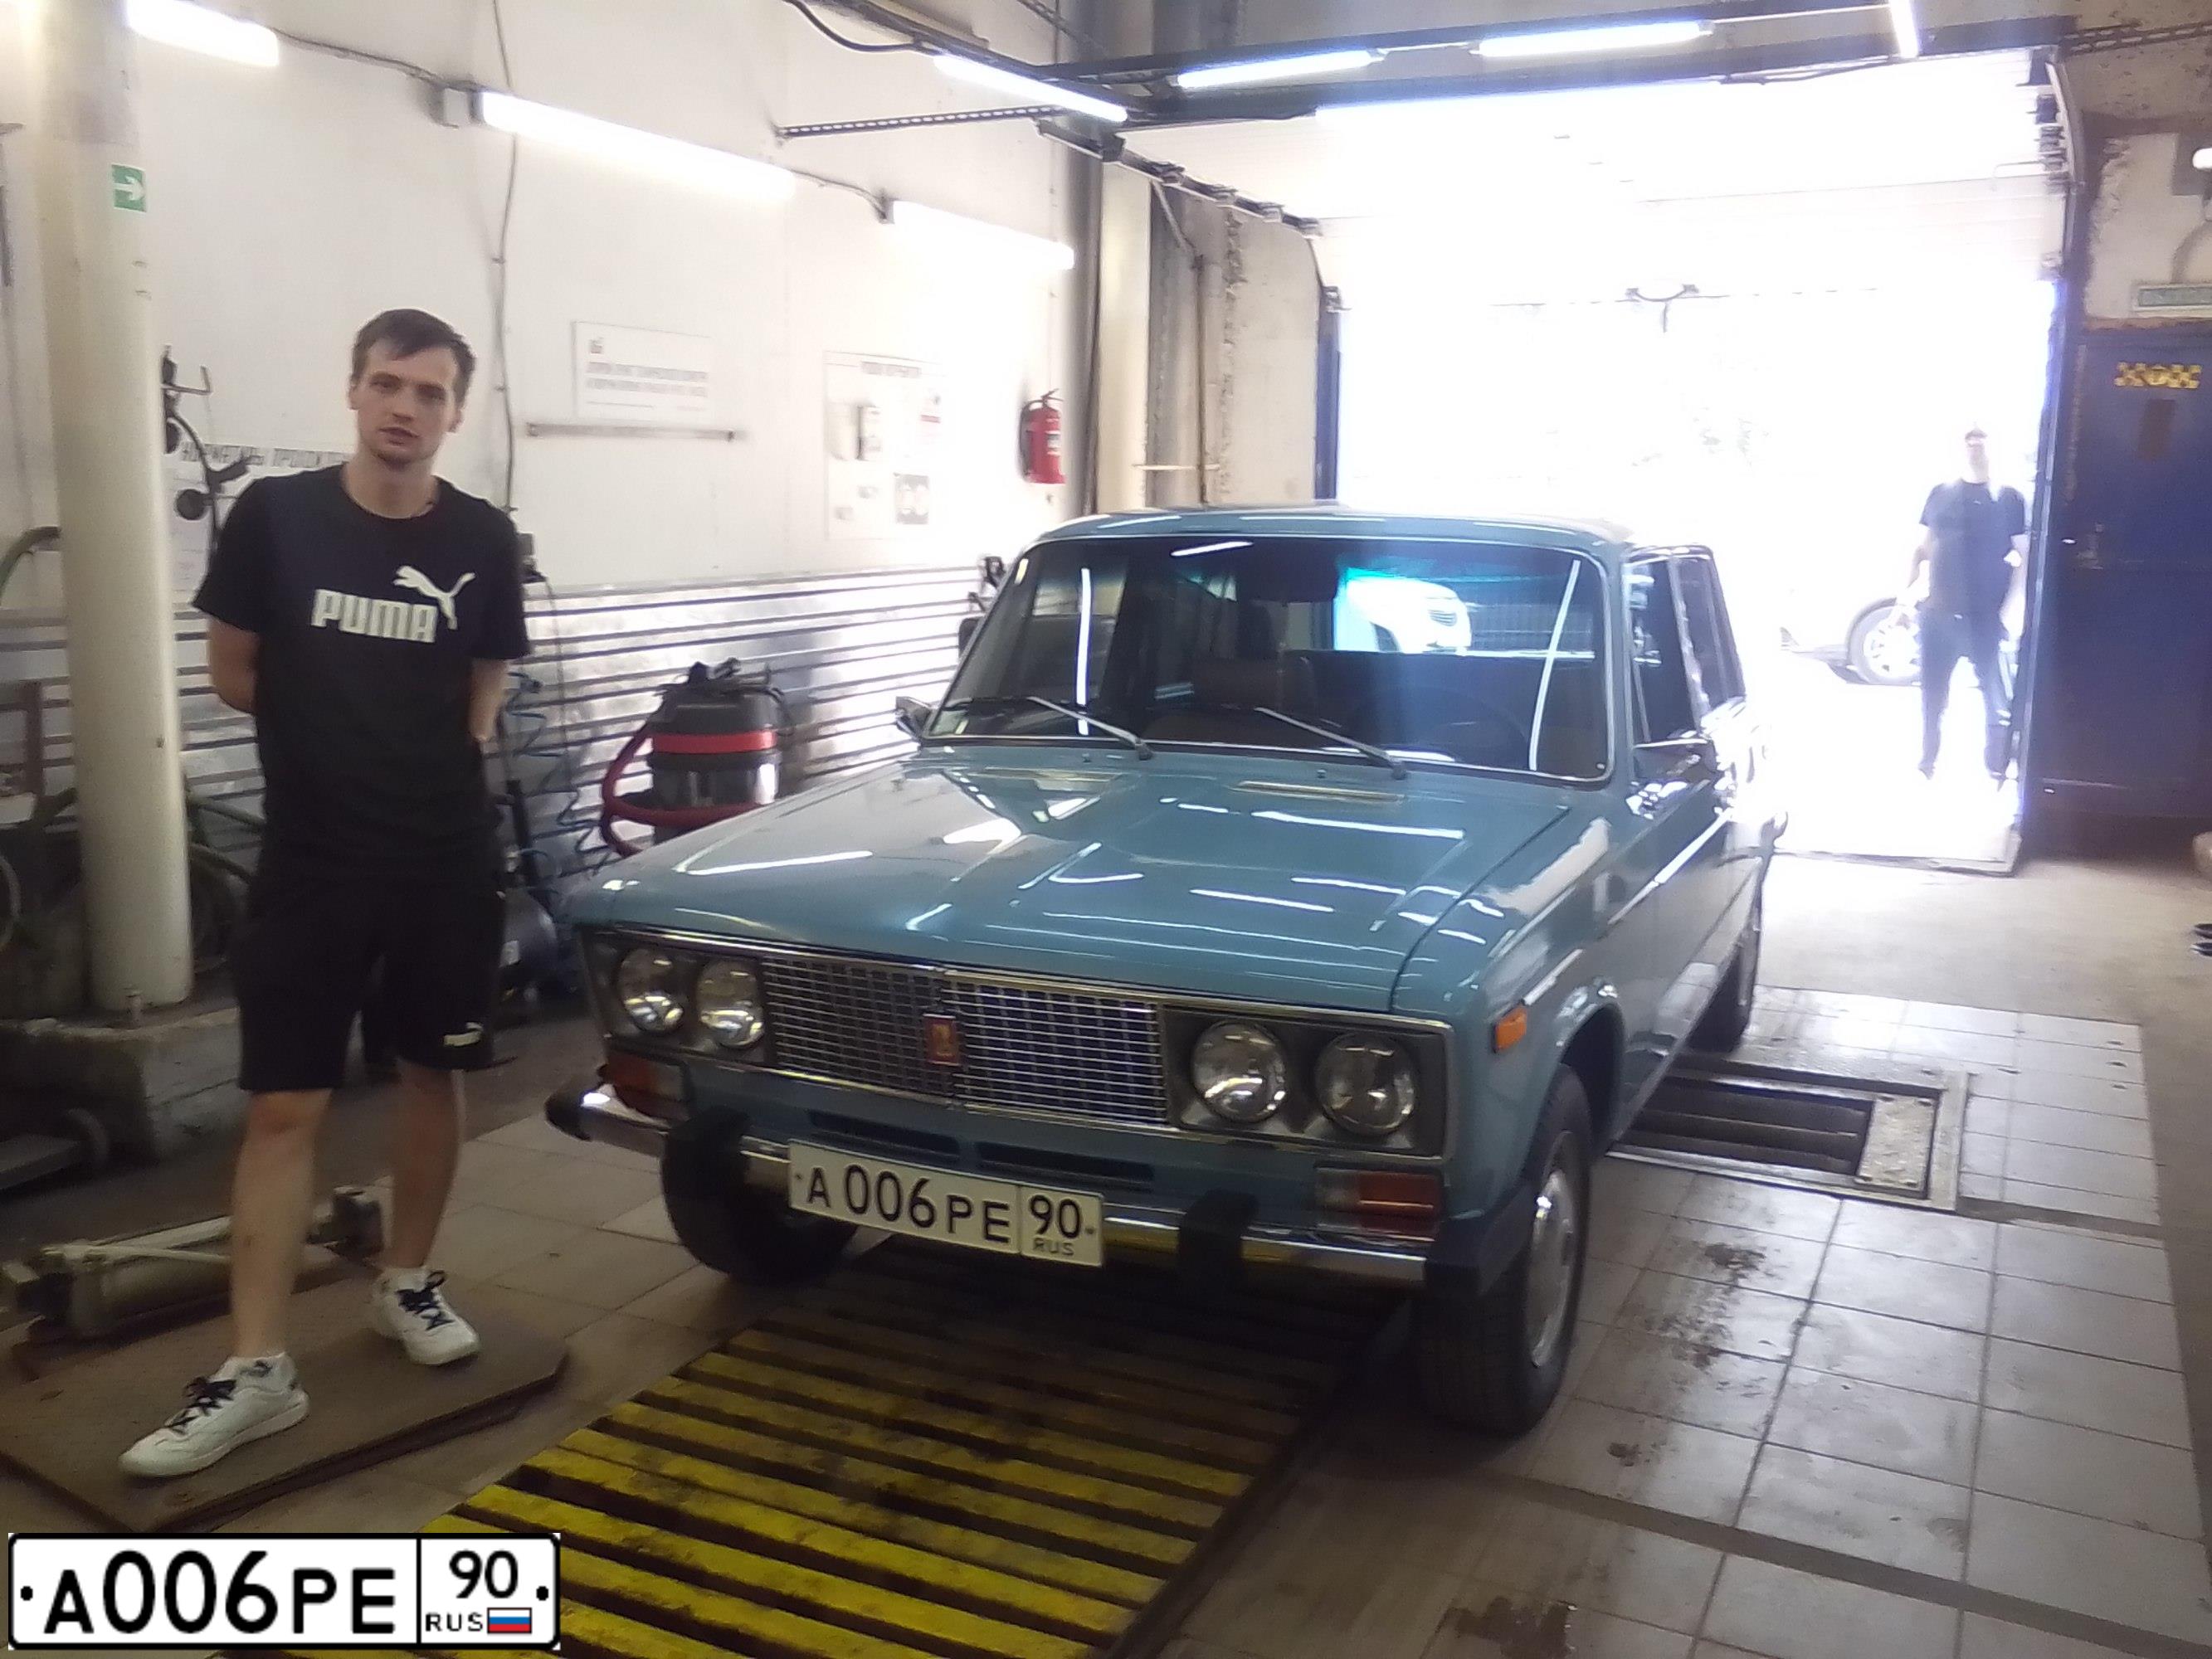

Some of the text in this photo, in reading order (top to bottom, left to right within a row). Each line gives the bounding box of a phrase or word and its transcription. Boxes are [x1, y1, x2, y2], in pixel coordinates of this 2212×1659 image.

[311, 588, 437, 643] PUMA
[1029, 1194, 1082, 1239] 90
[1032, 1238, 1074, 1257] RUS
